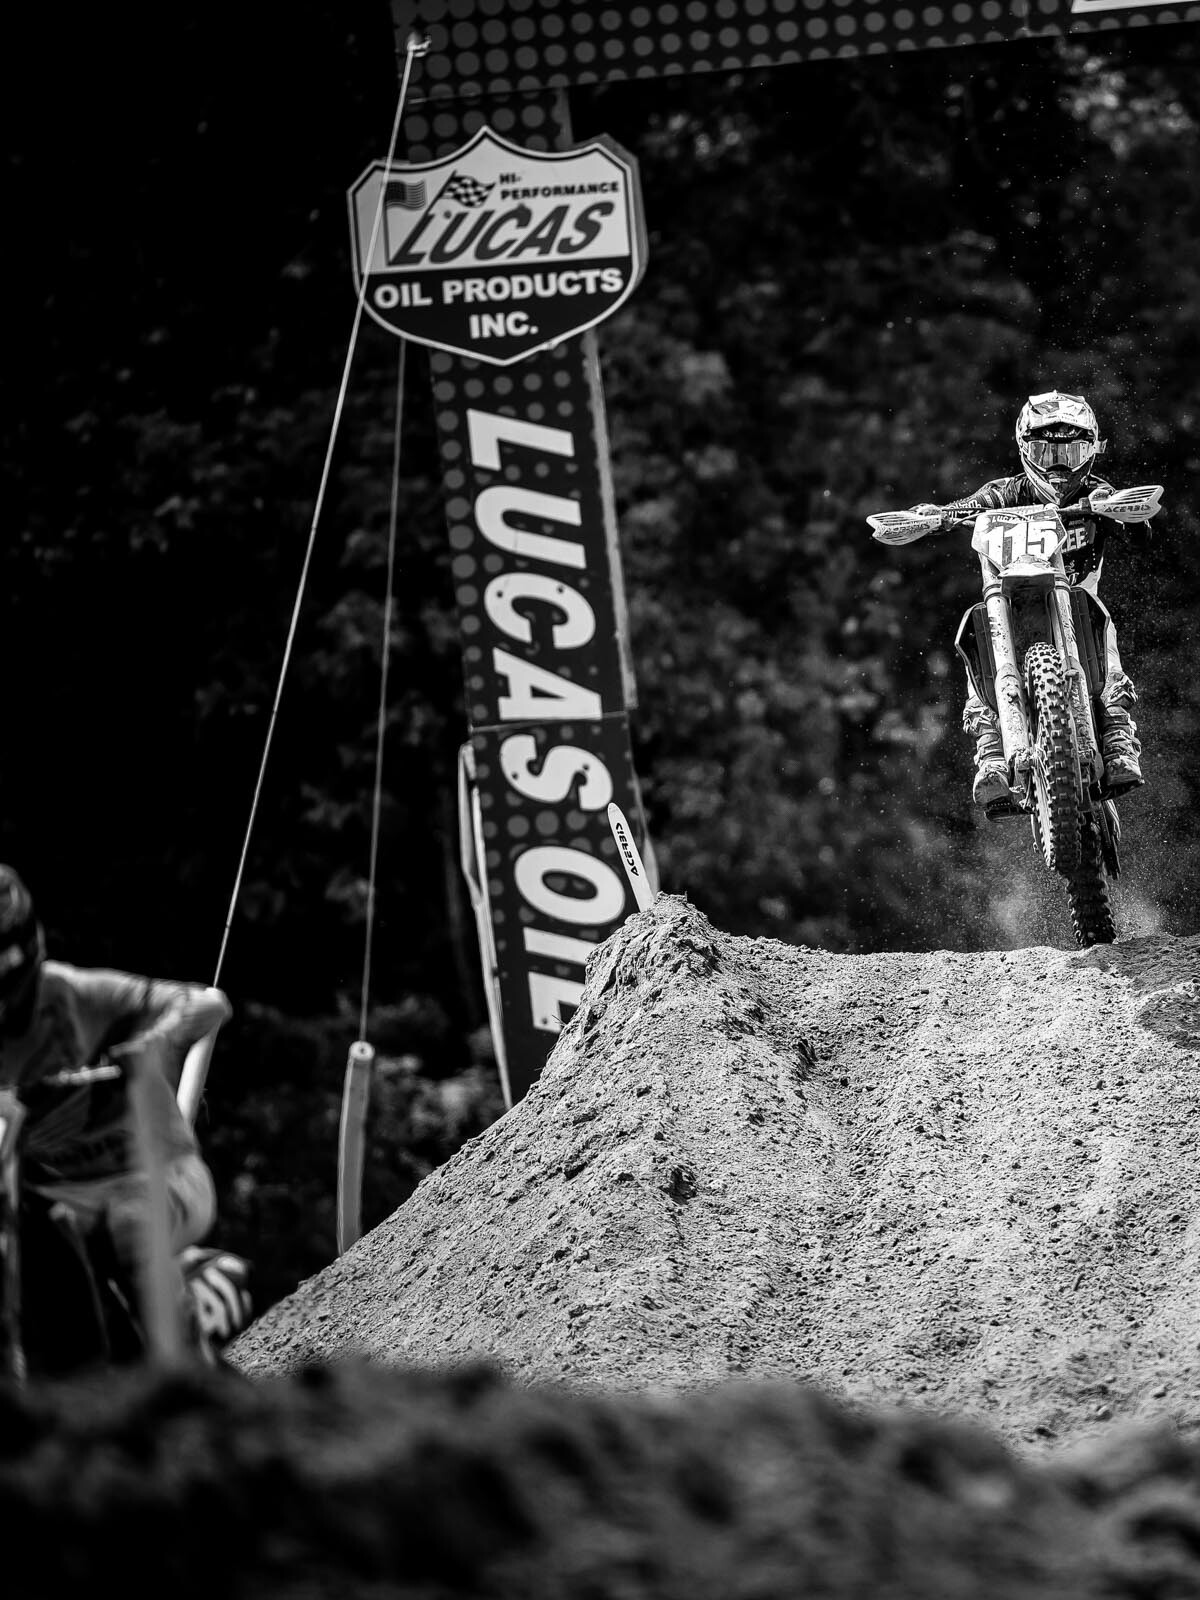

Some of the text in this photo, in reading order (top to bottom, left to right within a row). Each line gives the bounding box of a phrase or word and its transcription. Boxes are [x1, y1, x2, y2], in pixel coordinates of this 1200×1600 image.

[499, 172, 522, 184] HI-
[500, 181, 619, 200] PERFORMANCE
[387, 201, 615, 266] LUCAS
[373, 267, 624, 309] OIL PRODUCTS
[469, 311, 540, 339] INC.
[985, 520, 1059, 568] 115
[466, 408, 614, 812] LUCAS
[615, 822, 640, 877] ACERBIS
